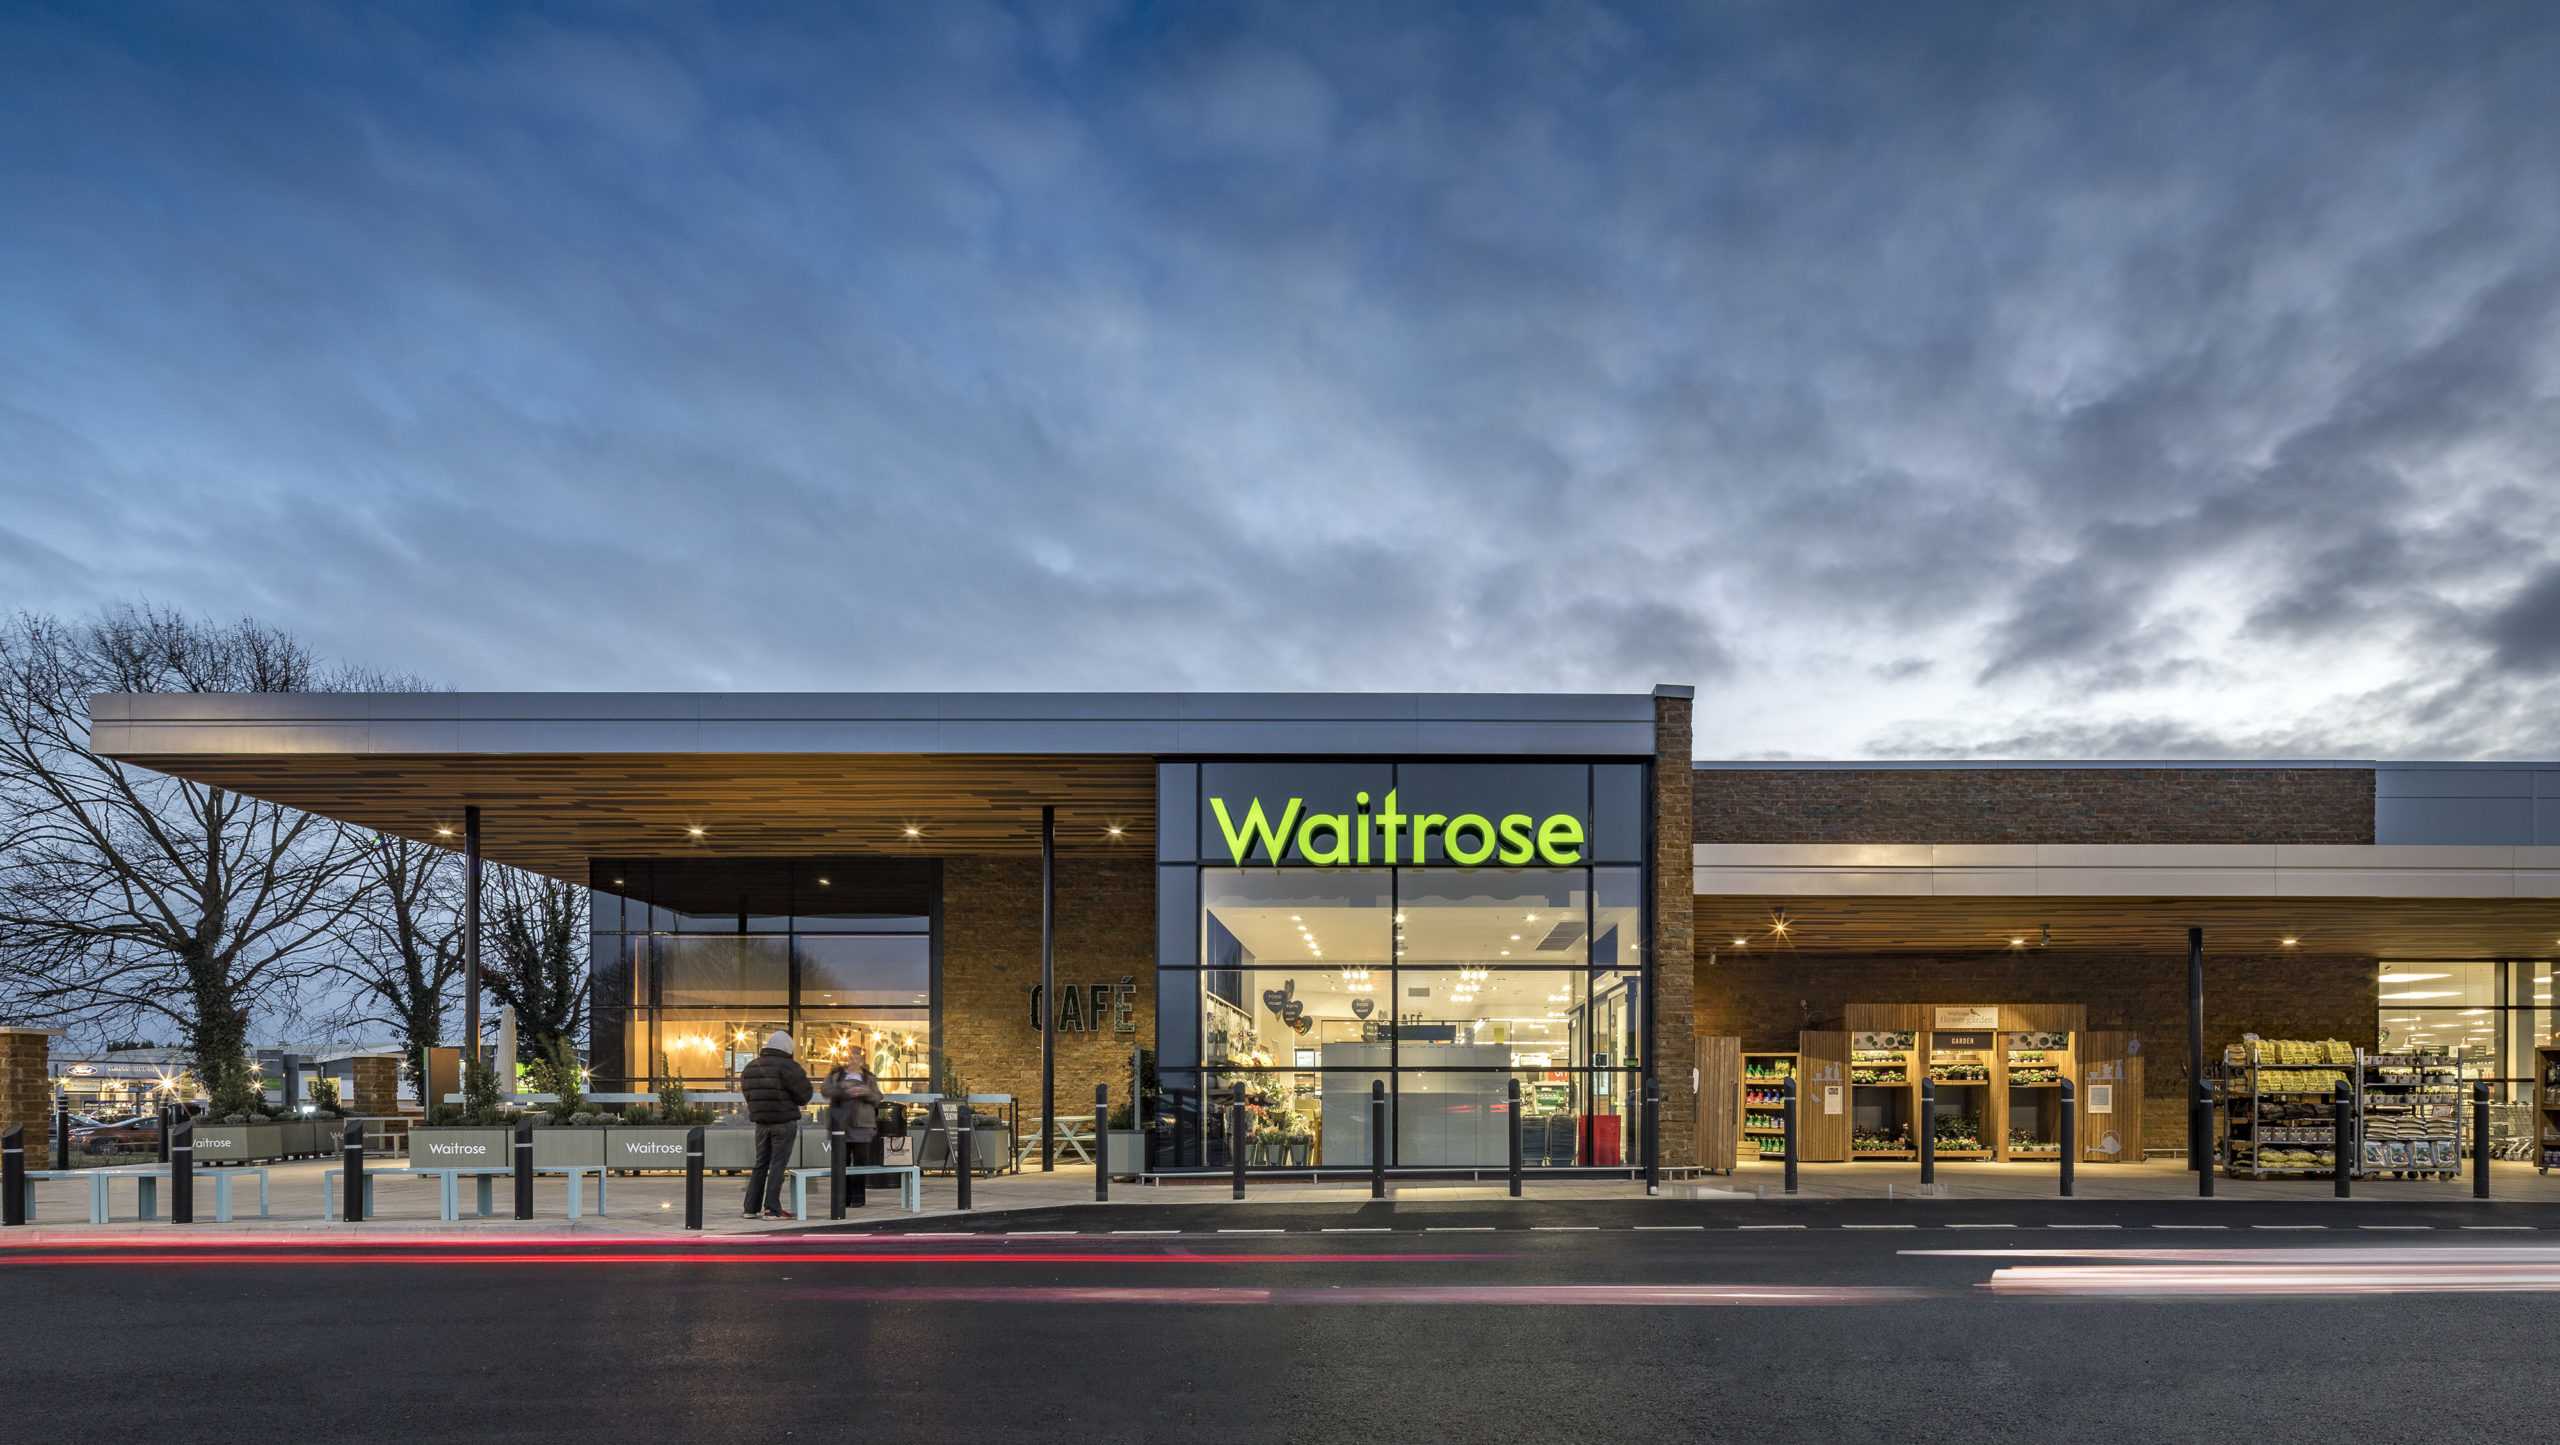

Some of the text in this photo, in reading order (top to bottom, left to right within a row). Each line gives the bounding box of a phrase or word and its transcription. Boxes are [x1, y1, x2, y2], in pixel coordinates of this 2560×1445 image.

[1209, 788, 1584, 866] Waitrose
[1029, 975, 1137, 1033] CAFÉ
[1951, 1037, 1974, 1045] GARDEN
[193, 1137, 232, 1149] aitrose
[428, 1142, 487, 1154] Waitrose
[625, 1141, 683, 1154] Waitrose
